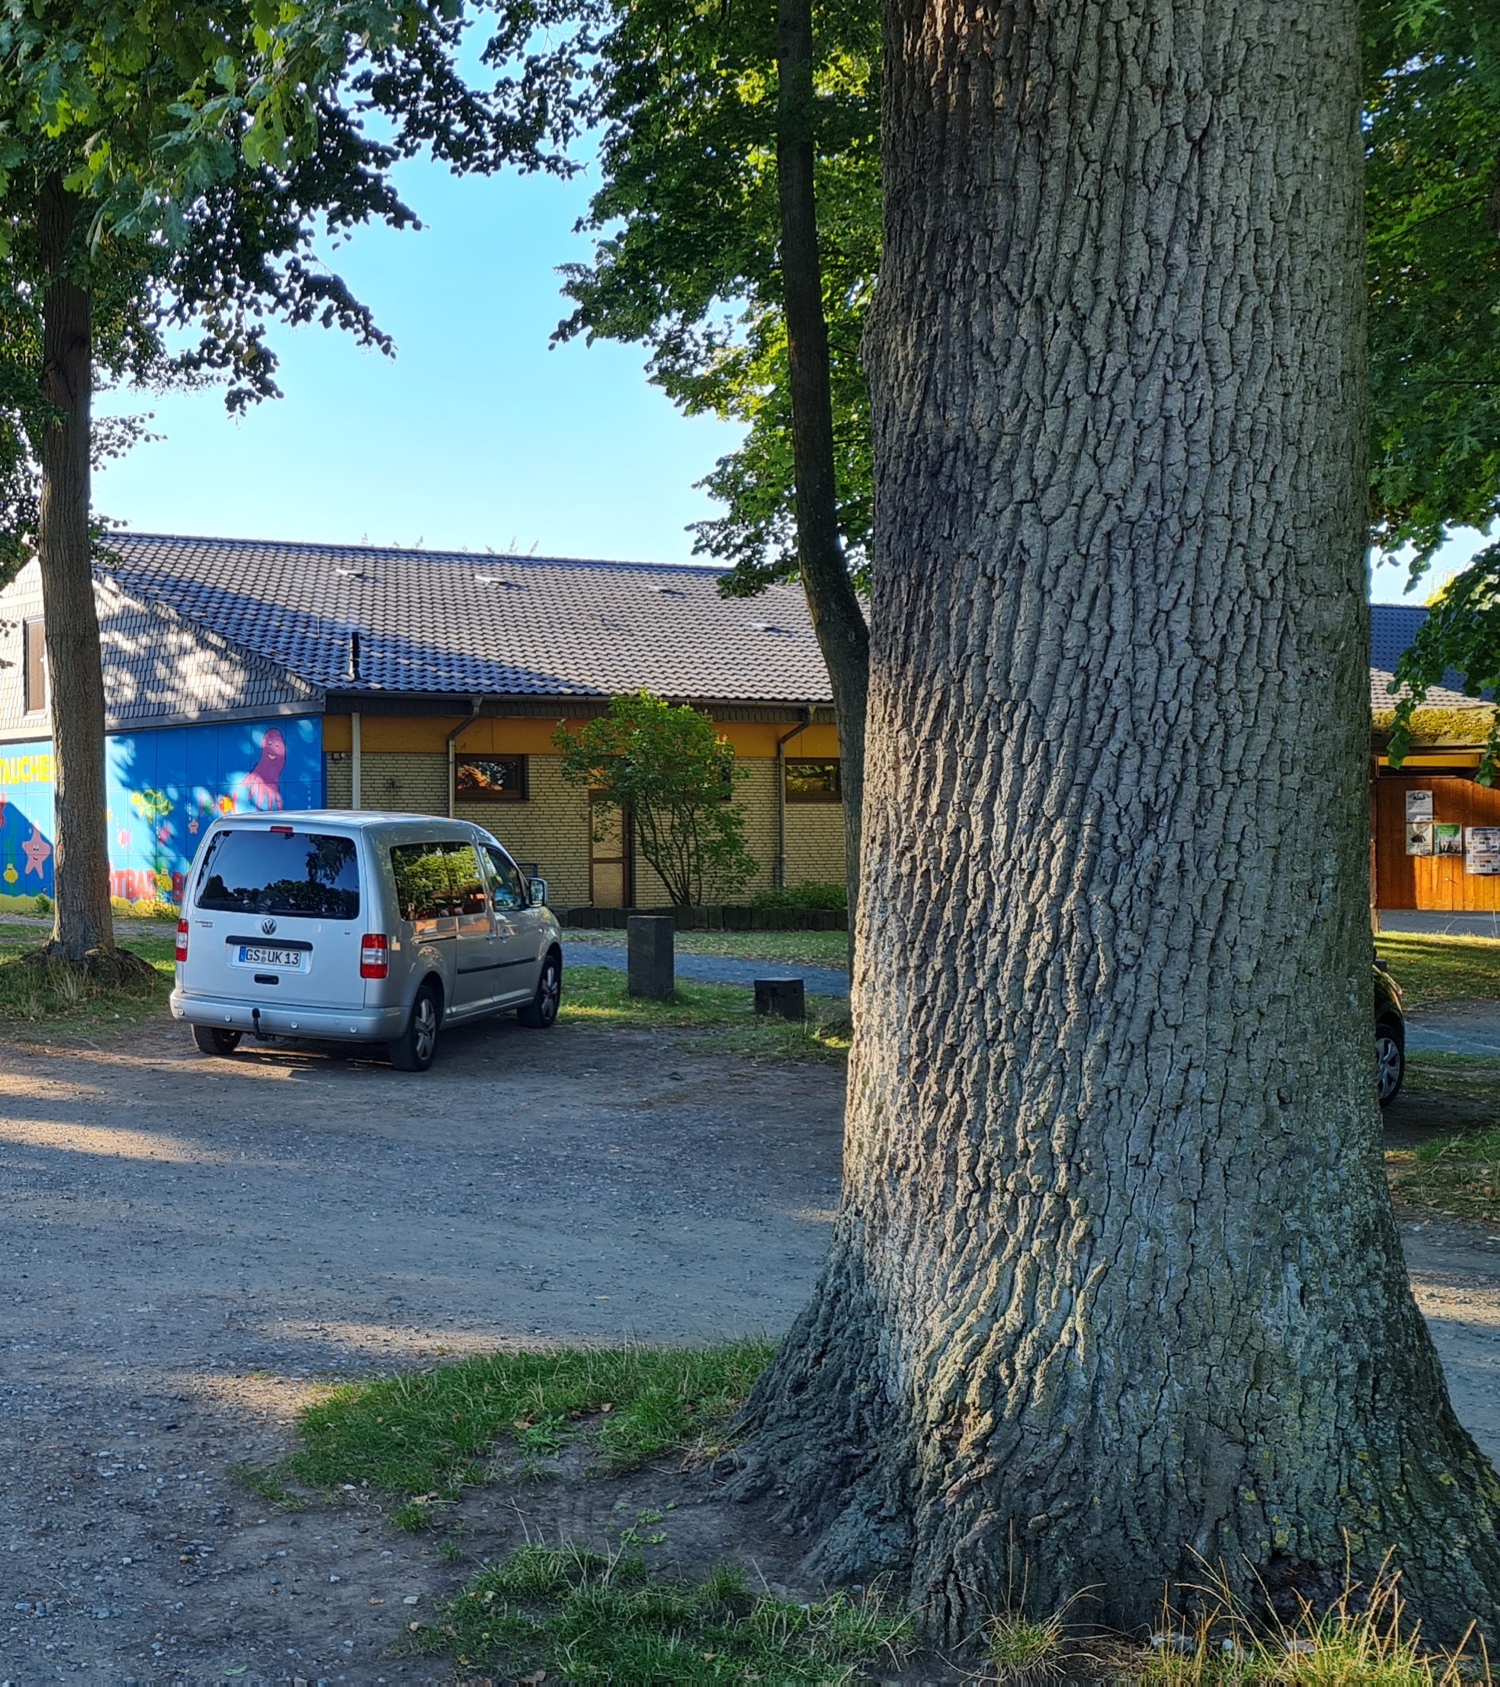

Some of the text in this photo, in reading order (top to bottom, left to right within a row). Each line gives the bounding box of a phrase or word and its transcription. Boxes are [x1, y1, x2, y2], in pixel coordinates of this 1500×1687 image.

[245, 948, 300, 965] GS UK 13
